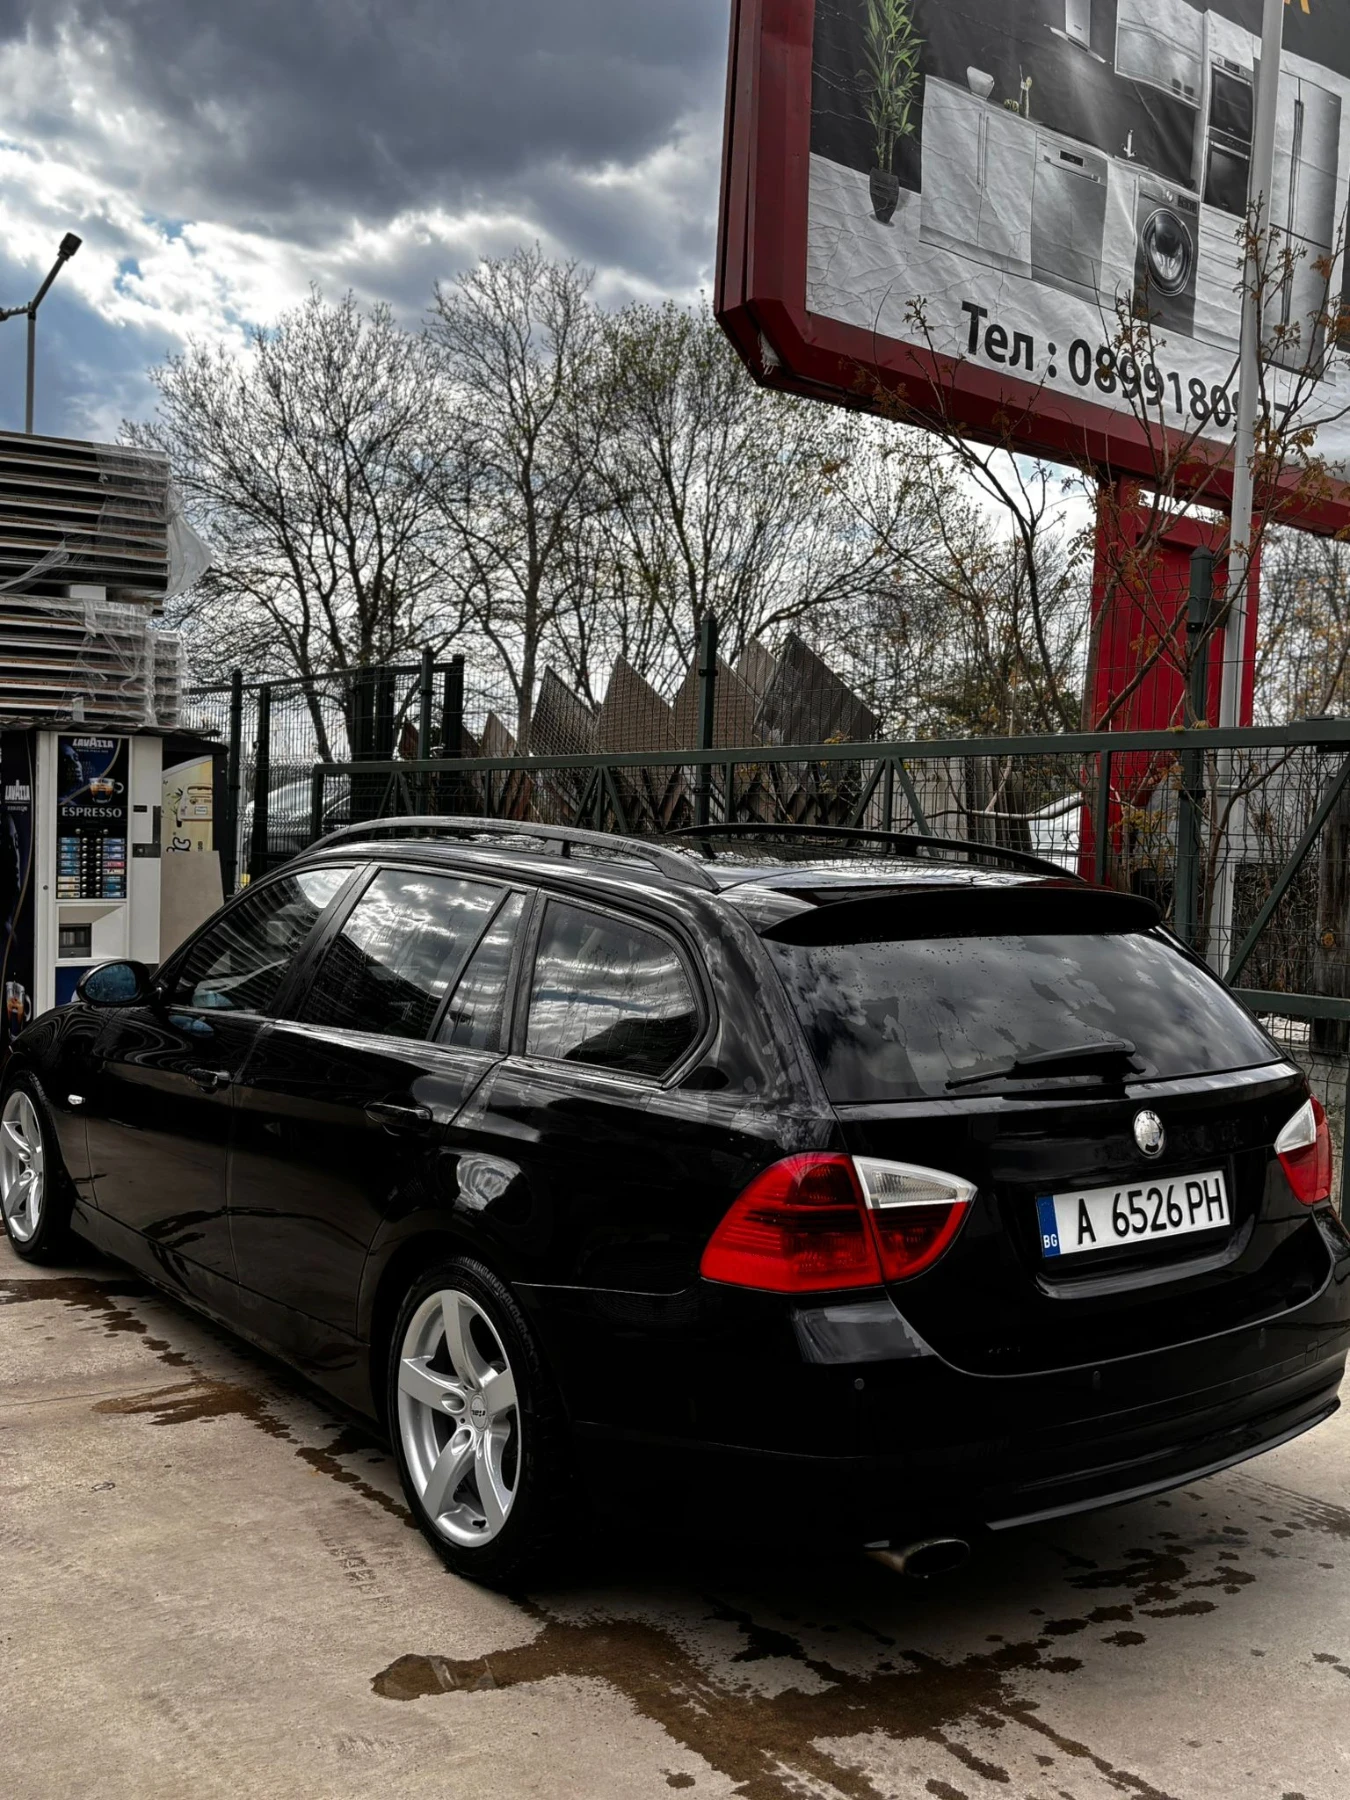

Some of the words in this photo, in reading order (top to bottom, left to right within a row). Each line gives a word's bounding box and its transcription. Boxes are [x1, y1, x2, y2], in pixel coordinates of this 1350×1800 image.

[961, 300, 1034, 372] Тел
[72, 736, 114, 748] LAVAZZA
[61, 806, 122, 818] ESPRESSO
[1077, 1198, 1097, 1245] A
[1112, 1184, 1183, 1237] 6526
[1043, 1234, 1058, 1249] BG
